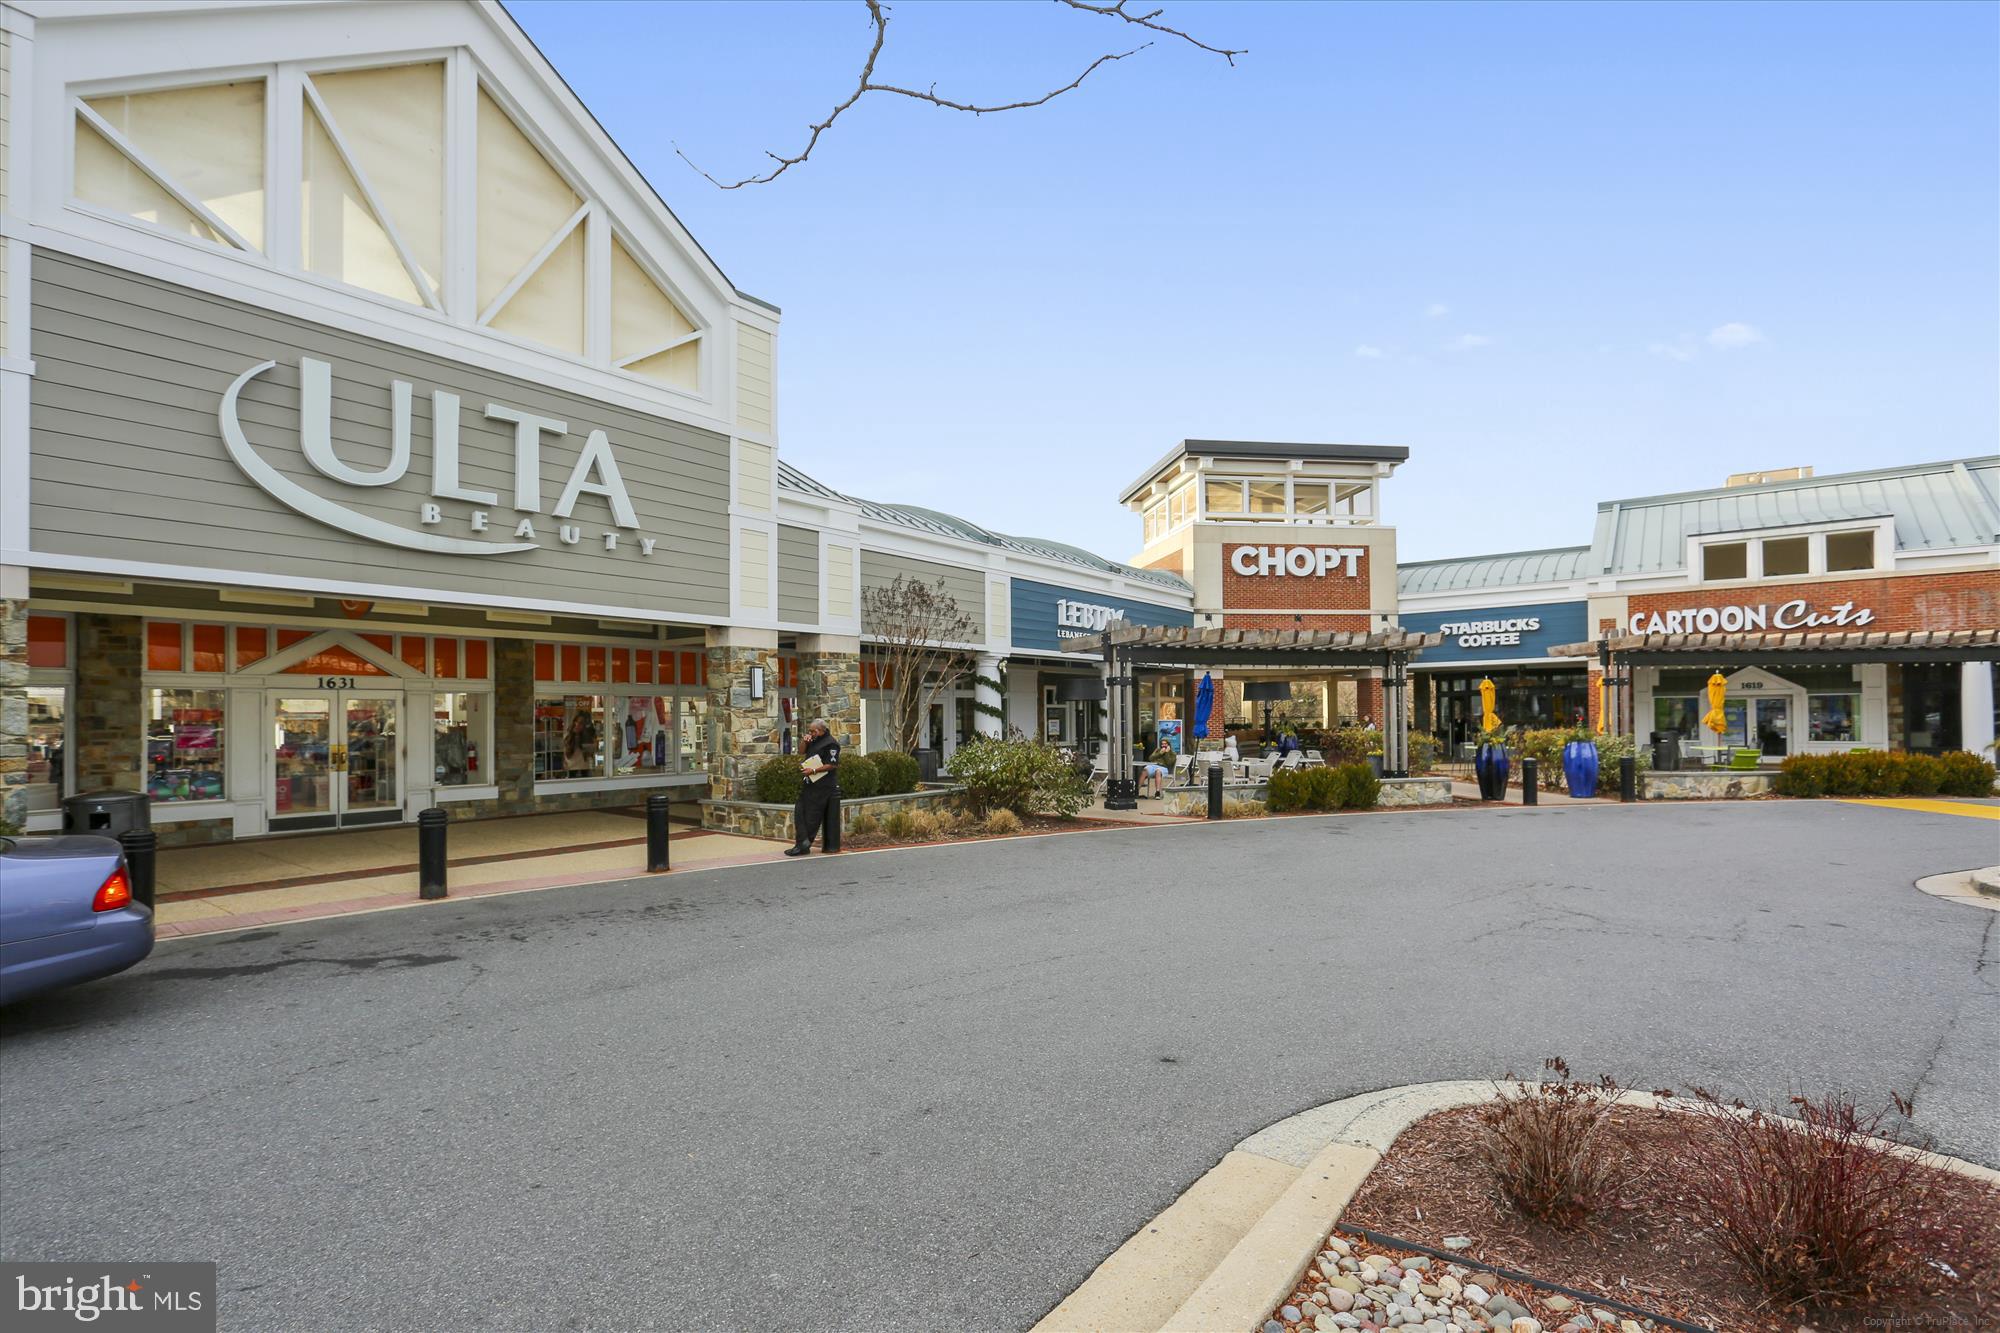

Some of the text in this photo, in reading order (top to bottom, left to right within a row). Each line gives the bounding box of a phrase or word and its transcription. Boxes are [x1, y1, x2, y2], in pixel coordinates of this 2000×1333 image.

[301, 356, 641, 530] ULTA
[421, 503, 657, 556] BEAUTY
[1230, 545, 1365, 577] CHOPT
[1439, 617, 1541, 636] STARBUCKS
[1629, 604, 1767, 636] CARTOON
[1773, 599, 1876, 630] Cuts
[1458, 632, 1521, 648] COFFEE
[318, 677, 356, 689] 1631
[1741, 681, 1764, 690] 1619
